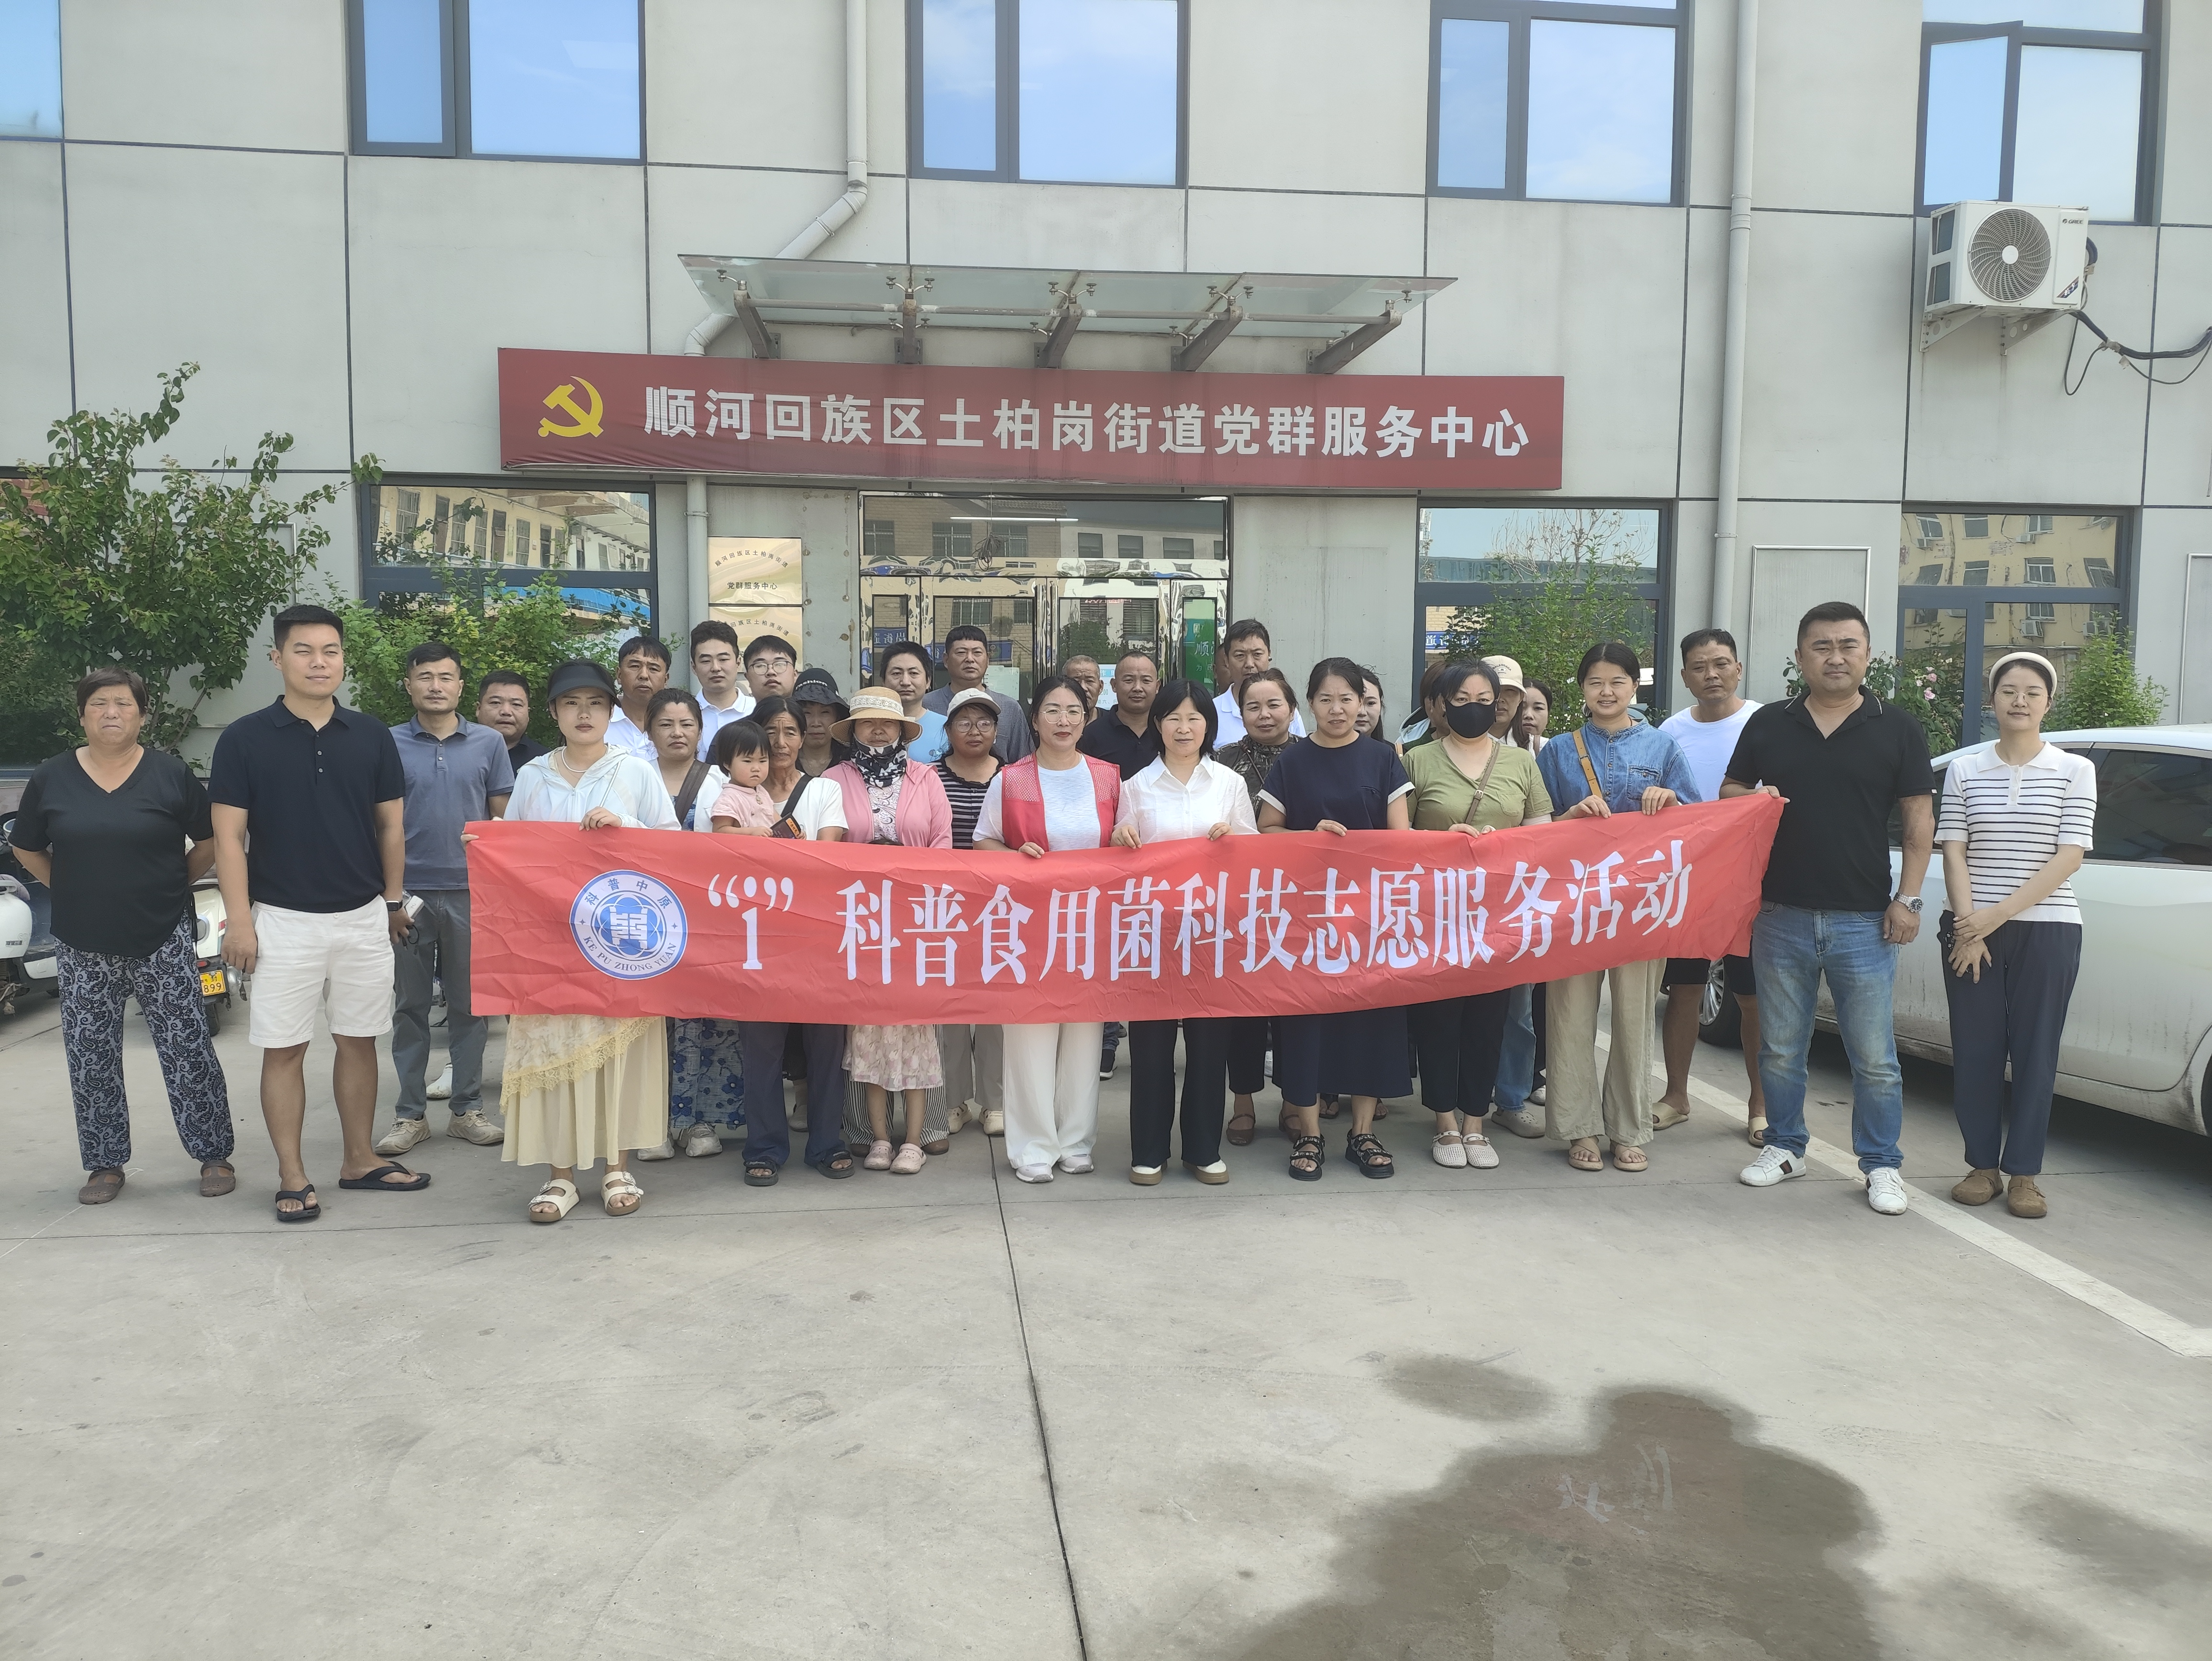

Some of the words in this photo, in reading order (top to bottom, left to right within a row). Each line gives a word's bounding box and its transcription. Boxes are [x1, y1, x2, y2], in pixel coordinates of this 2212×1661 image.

[644, 386, 1529, 458] 顺河回族区土柏岗街道党群服务中心
[715, 550, 788, 568] 顺河回族区土柏岗街道
[727, 582, 777, 590] 党群服务中心
[730, 619, 789, 636] 回族区土柏岗街道
[584, 877, 673, 909] 科普中原
[836, 839, 1693, 987] 科普食用菌科技志愿服务活动
[583, 936, 597, 952] KE
[597, 952, 612, 965] PU
[614, 962, 653, 972] ZHONG
[654, 942, 677, 966] YUAN
